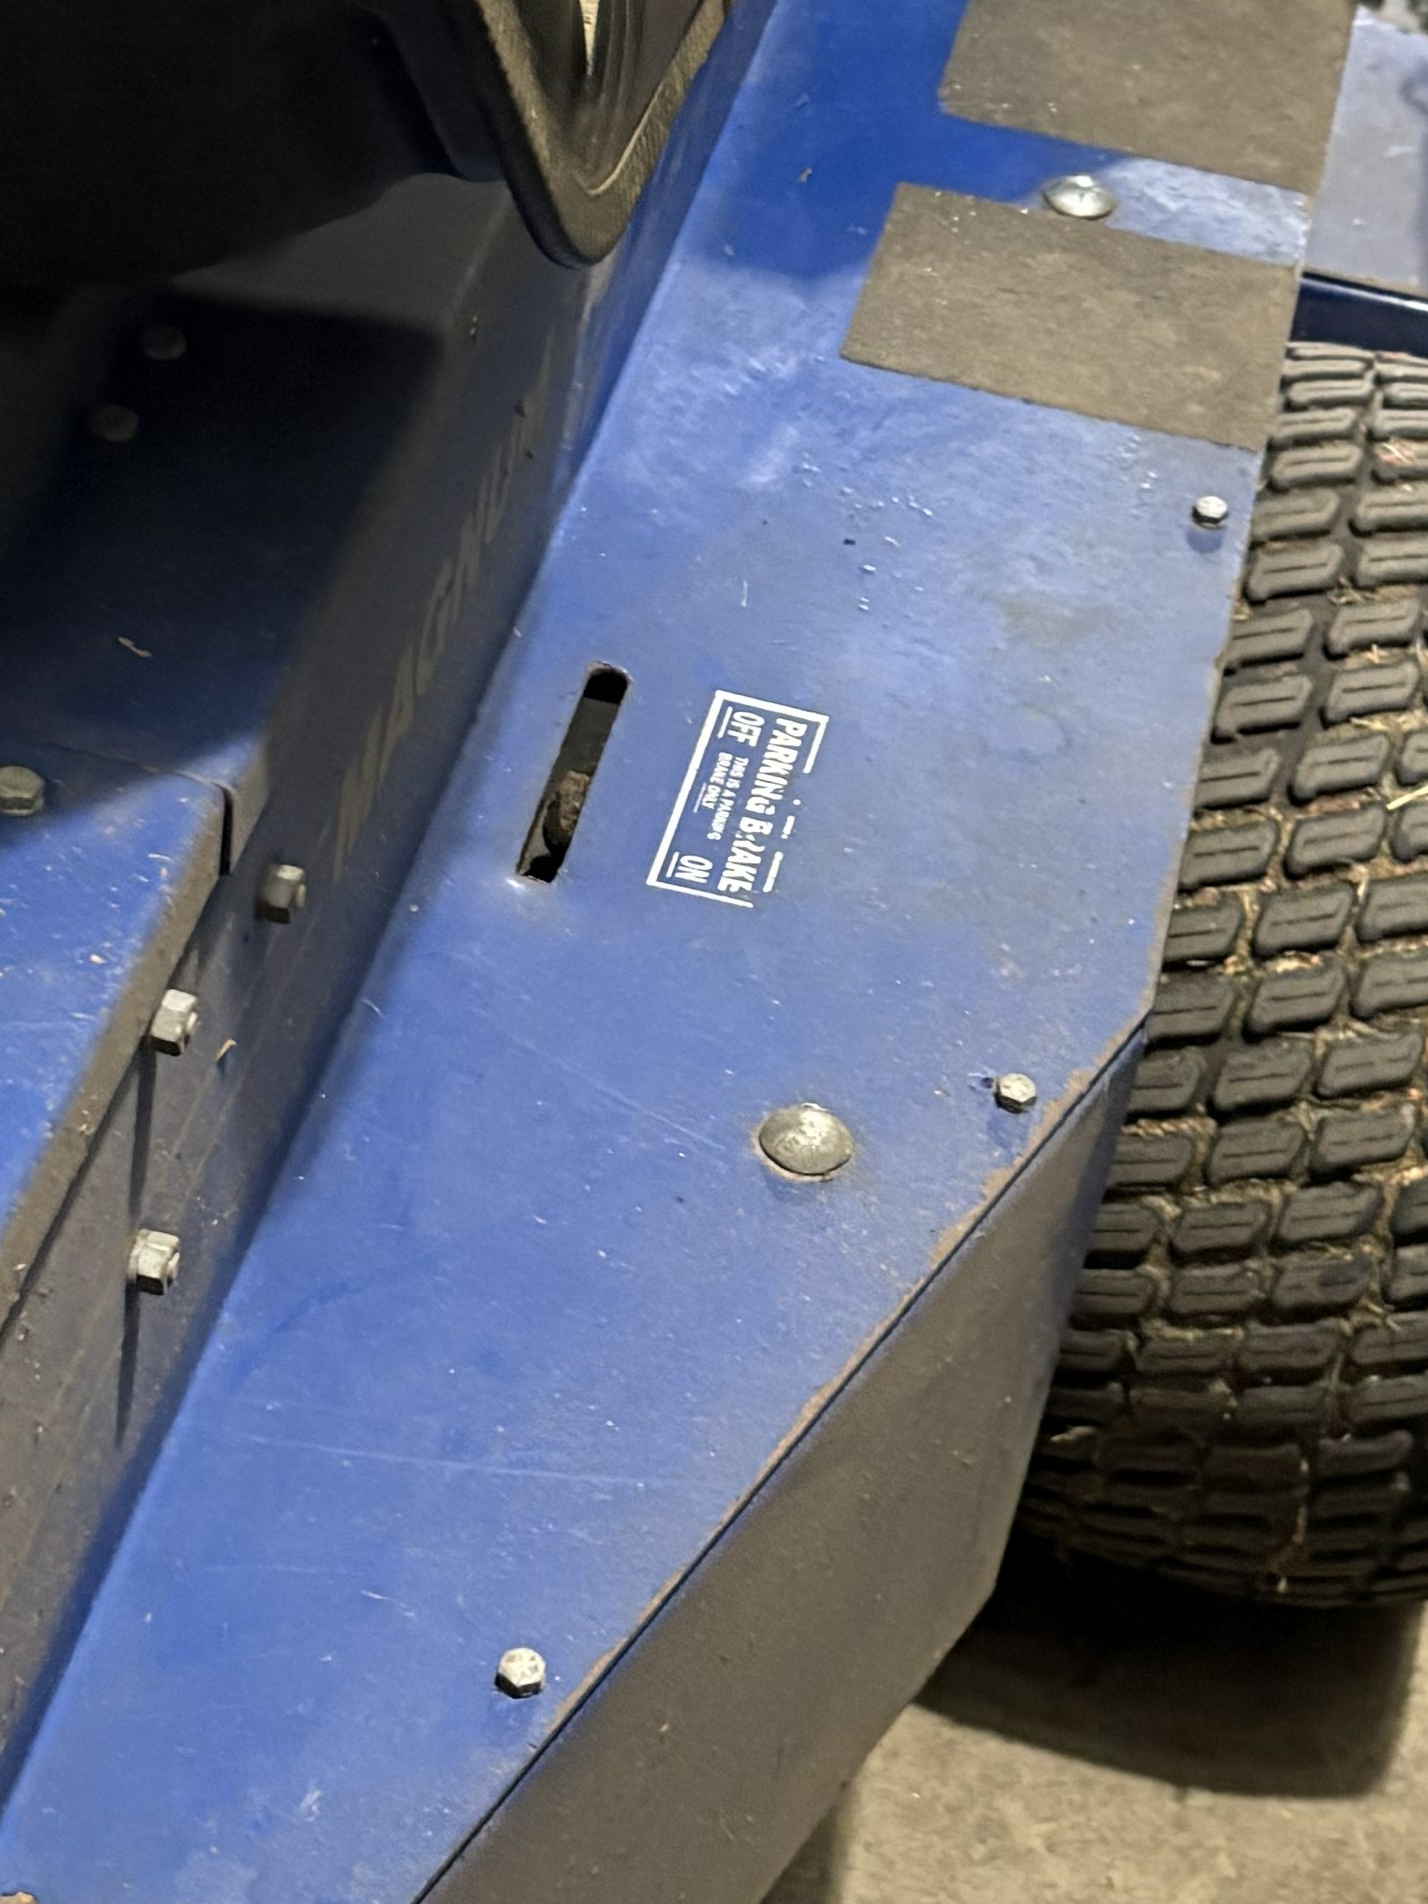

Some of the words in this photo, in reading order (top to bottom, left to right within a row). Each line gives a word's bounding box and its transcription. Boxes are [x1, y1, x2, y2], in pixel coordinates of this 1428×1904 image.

[726, 711, 766, 747] OFF
[731, 757, 749, 778] THIS
[745, 717, 808, 816] PARKING
[701, 784, 722, 811] ONLY
[674, 853, 713, 884] ON
[717, 816, 774, 893] BRAKE
